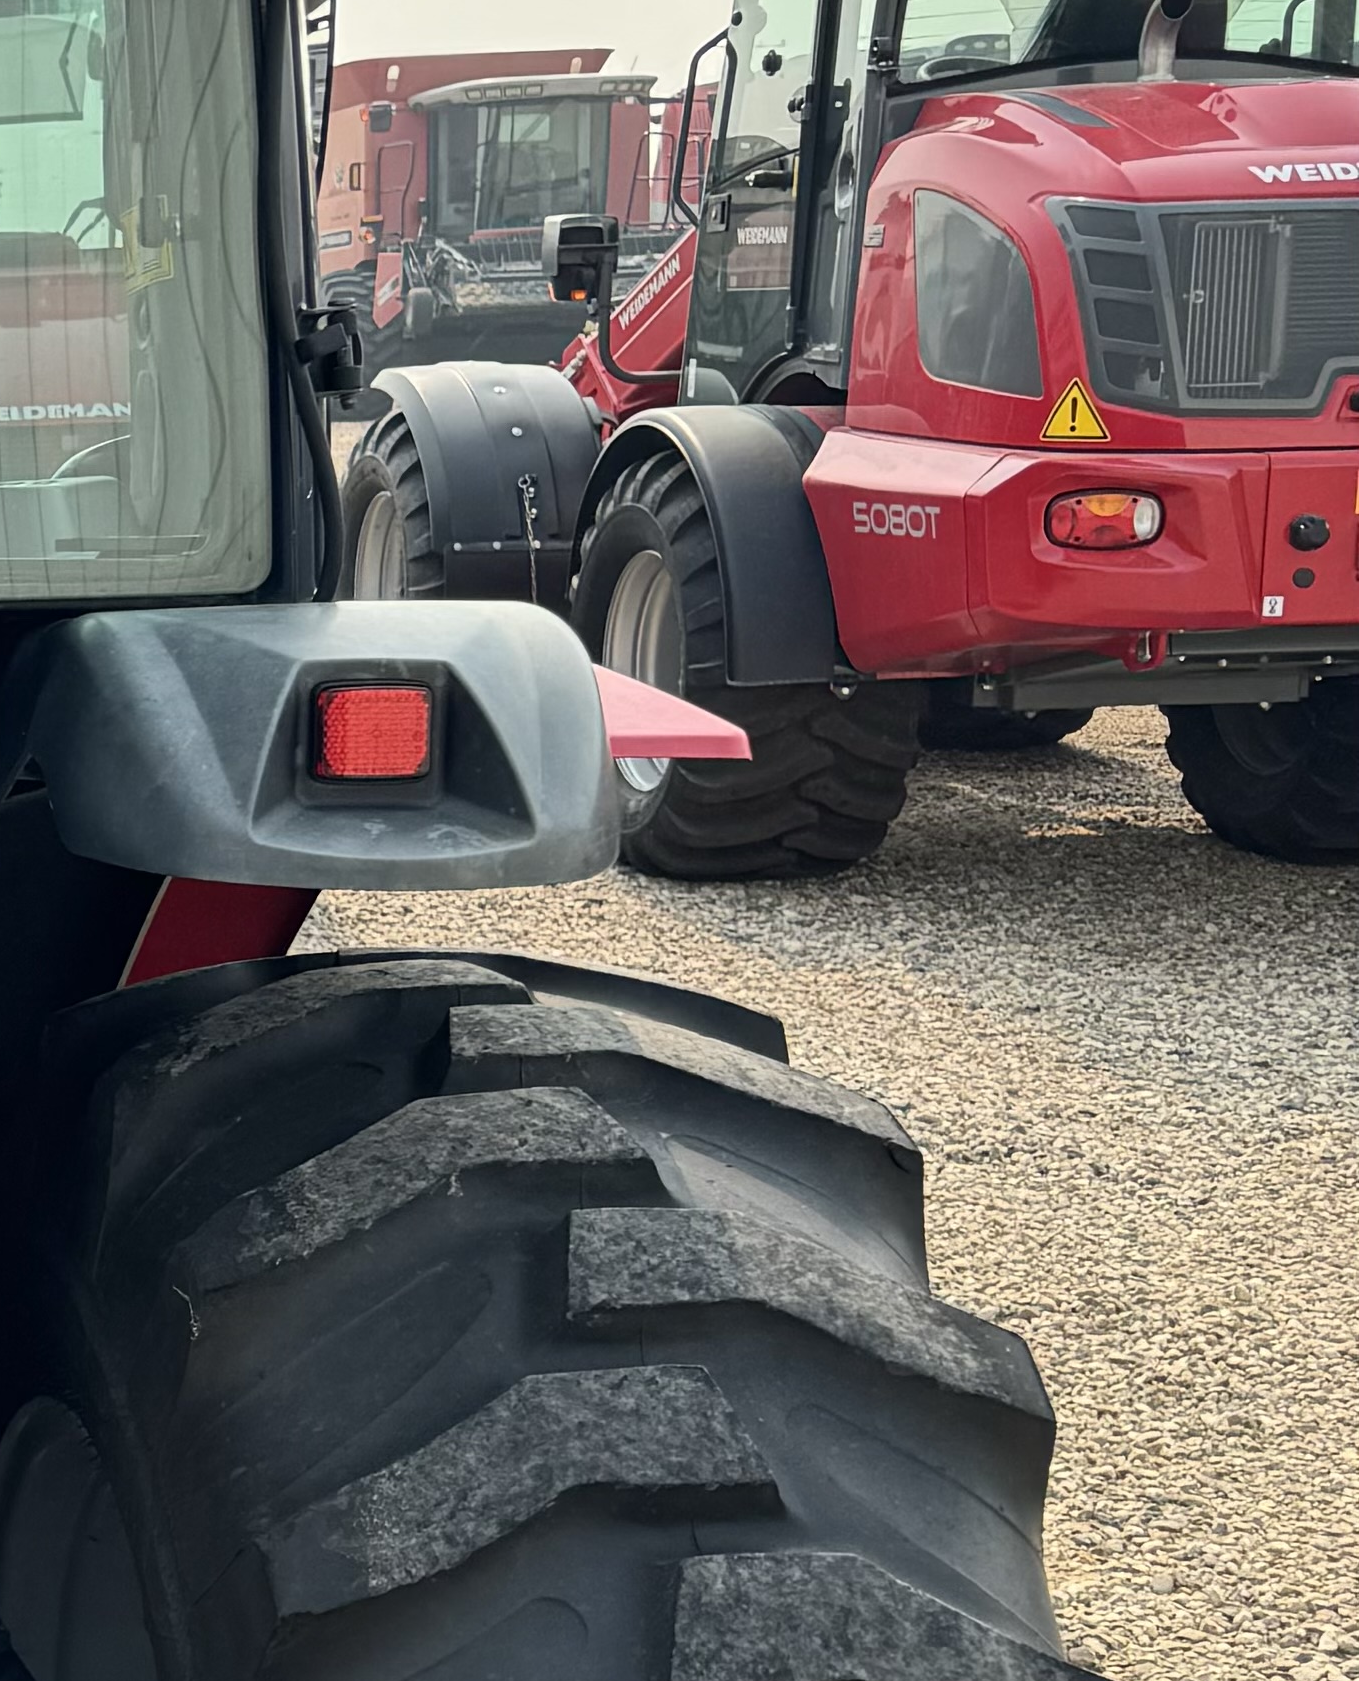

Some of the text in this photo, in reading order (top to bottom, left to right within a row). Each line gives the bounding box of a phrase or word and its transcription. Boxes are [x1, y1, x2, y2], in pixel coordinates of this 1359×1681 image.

[1247, 162, 1359, 184] WEID
[617, 252, 682, 331] WEIDEMANN
[852, 501, 941, 539] 5080T
